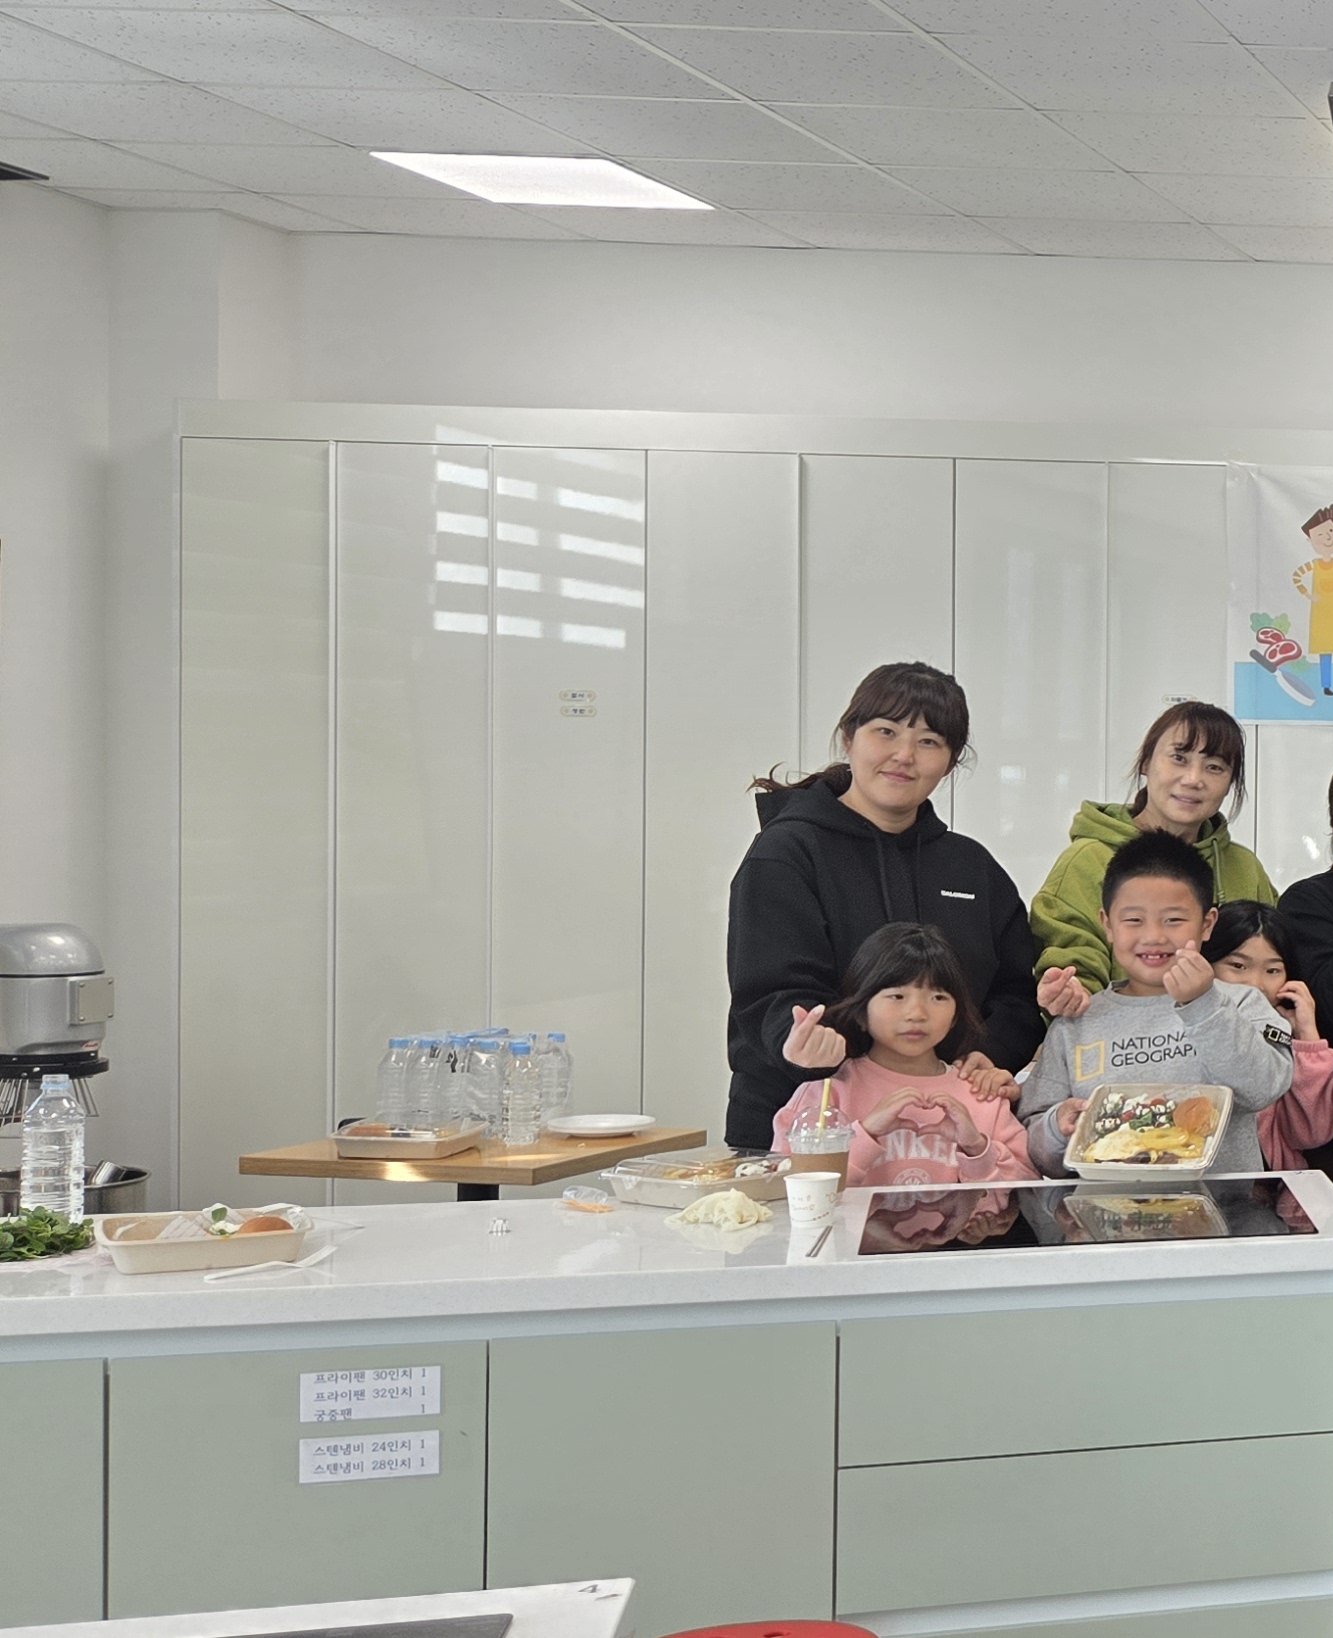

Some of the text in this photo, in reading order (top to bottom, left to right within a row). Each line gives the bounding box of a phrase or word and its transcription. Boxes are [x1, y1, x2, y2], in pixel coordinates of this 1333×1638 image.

[313, 1367, 427, 1384] 프라이팬 30인치 1
[313, 1386, 427, 1402] 프라이팬 32인치 1
[420, 1404, 427, 1414] 1
[371, 1439, 412, 1453] 24인치
[420, 1439, 426, 1449] 1
[371, 1458, 412, 1471] 28인치
[420, 1457, 426, 1467] 1
